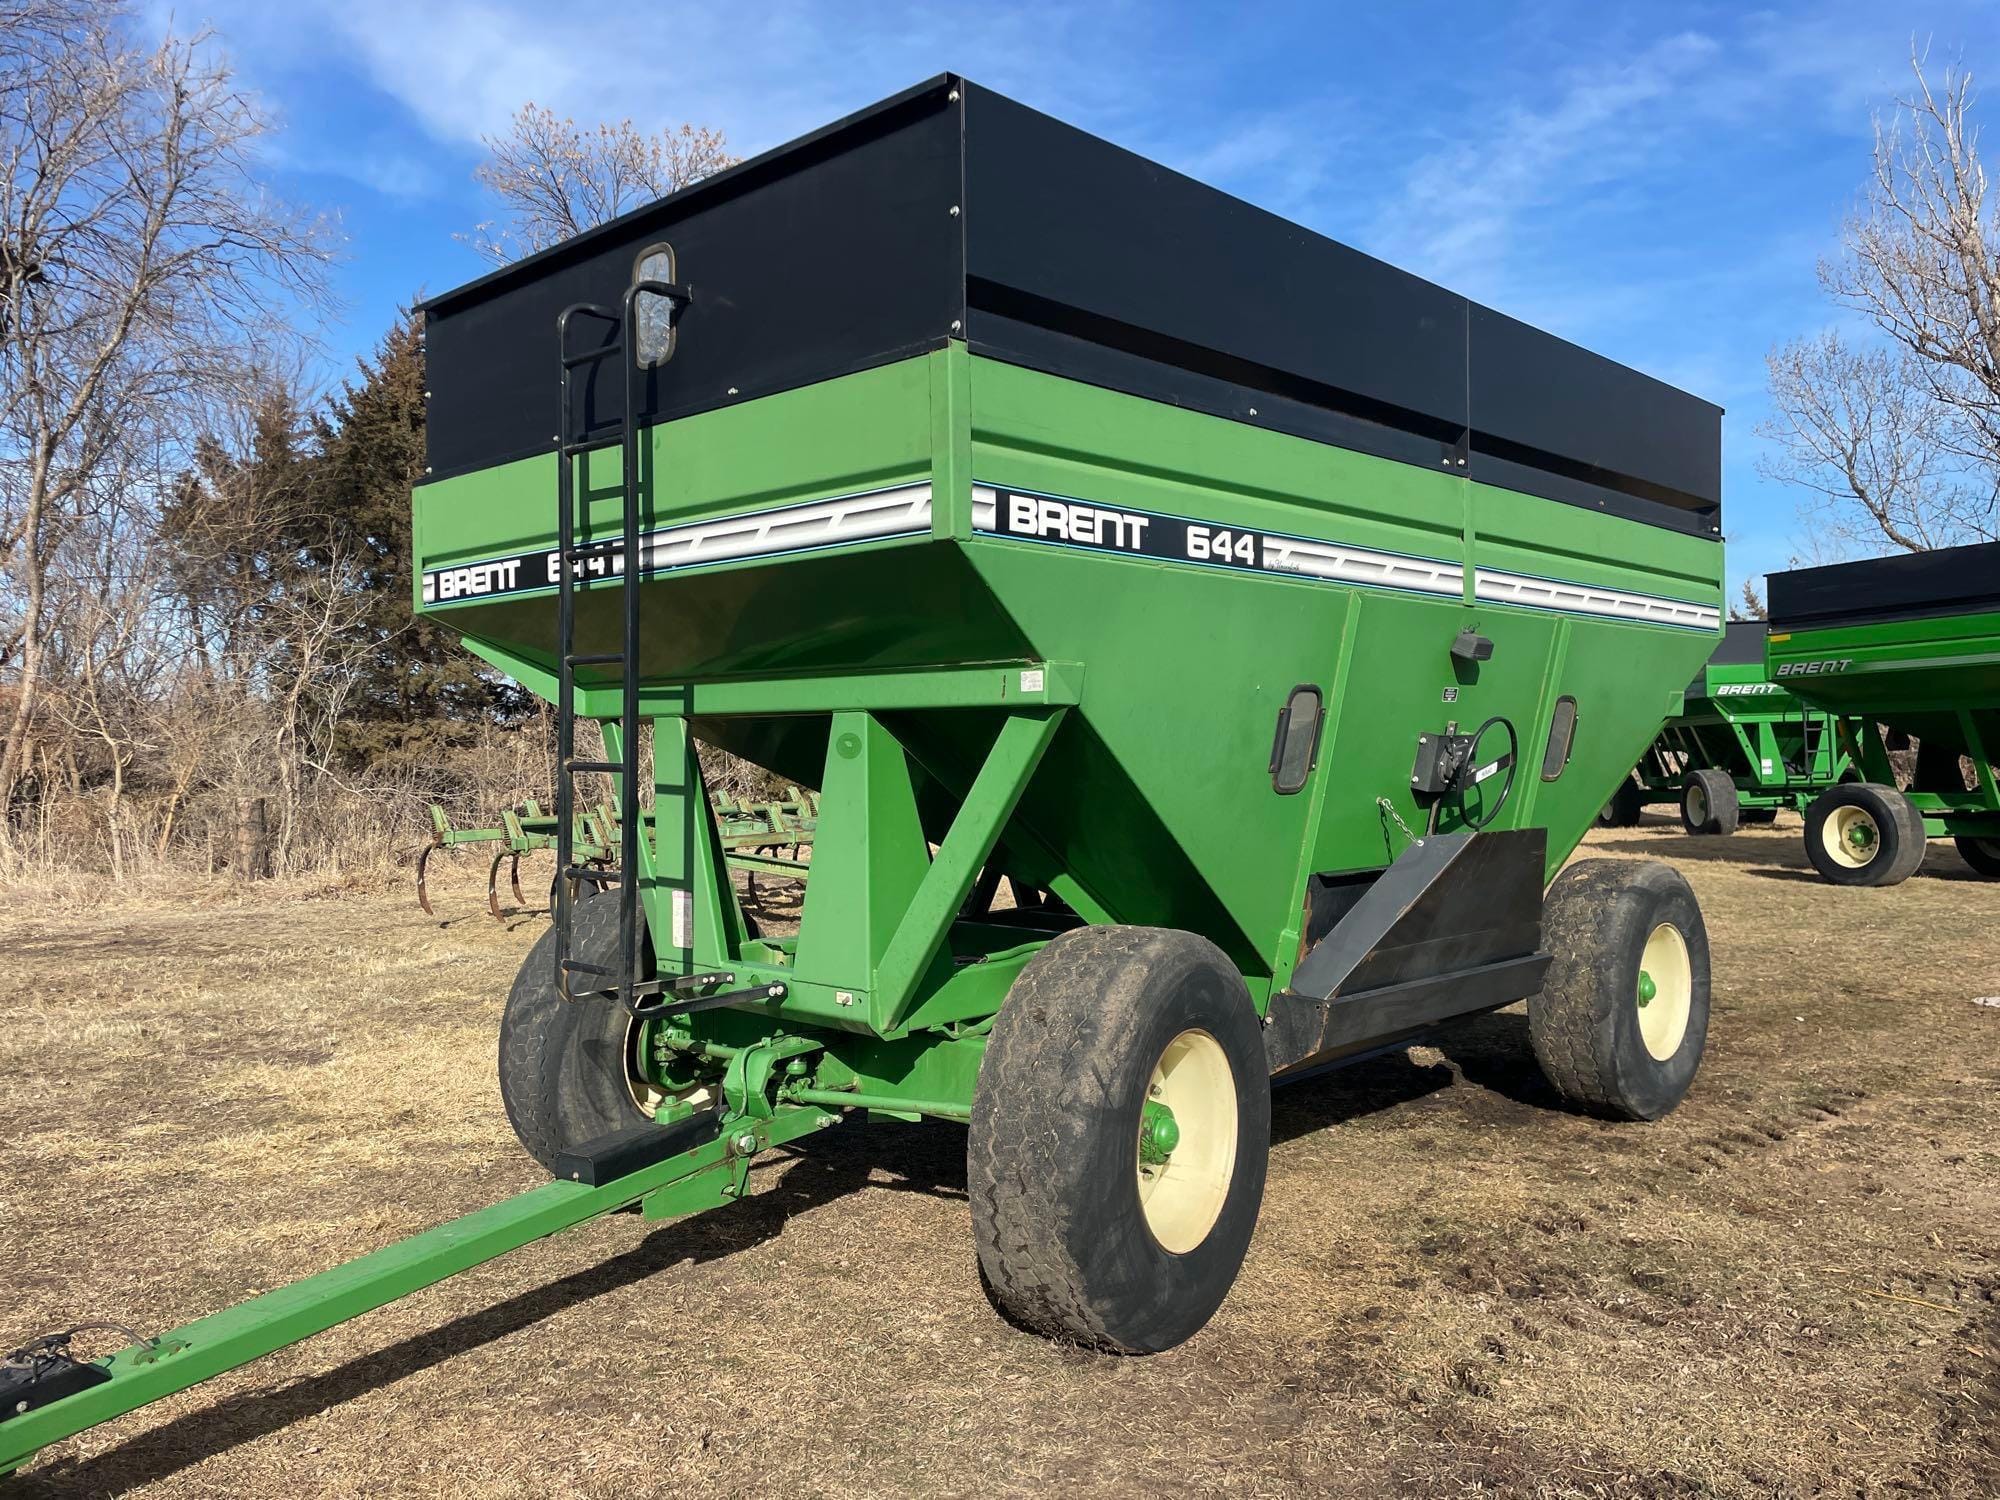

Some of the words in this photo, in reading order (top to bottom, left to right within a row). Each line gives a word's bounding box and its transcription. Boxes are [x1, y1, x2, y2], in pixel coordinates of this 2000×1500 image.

[1008, 494, 1149, 550] BRENT
[1187, 525, 1254, 566] 644
[439, 559, 521, 599] BRENT
[1776, 659, 1852, 676] BRENT
[1717, 684, 1778, 695] BRENT
